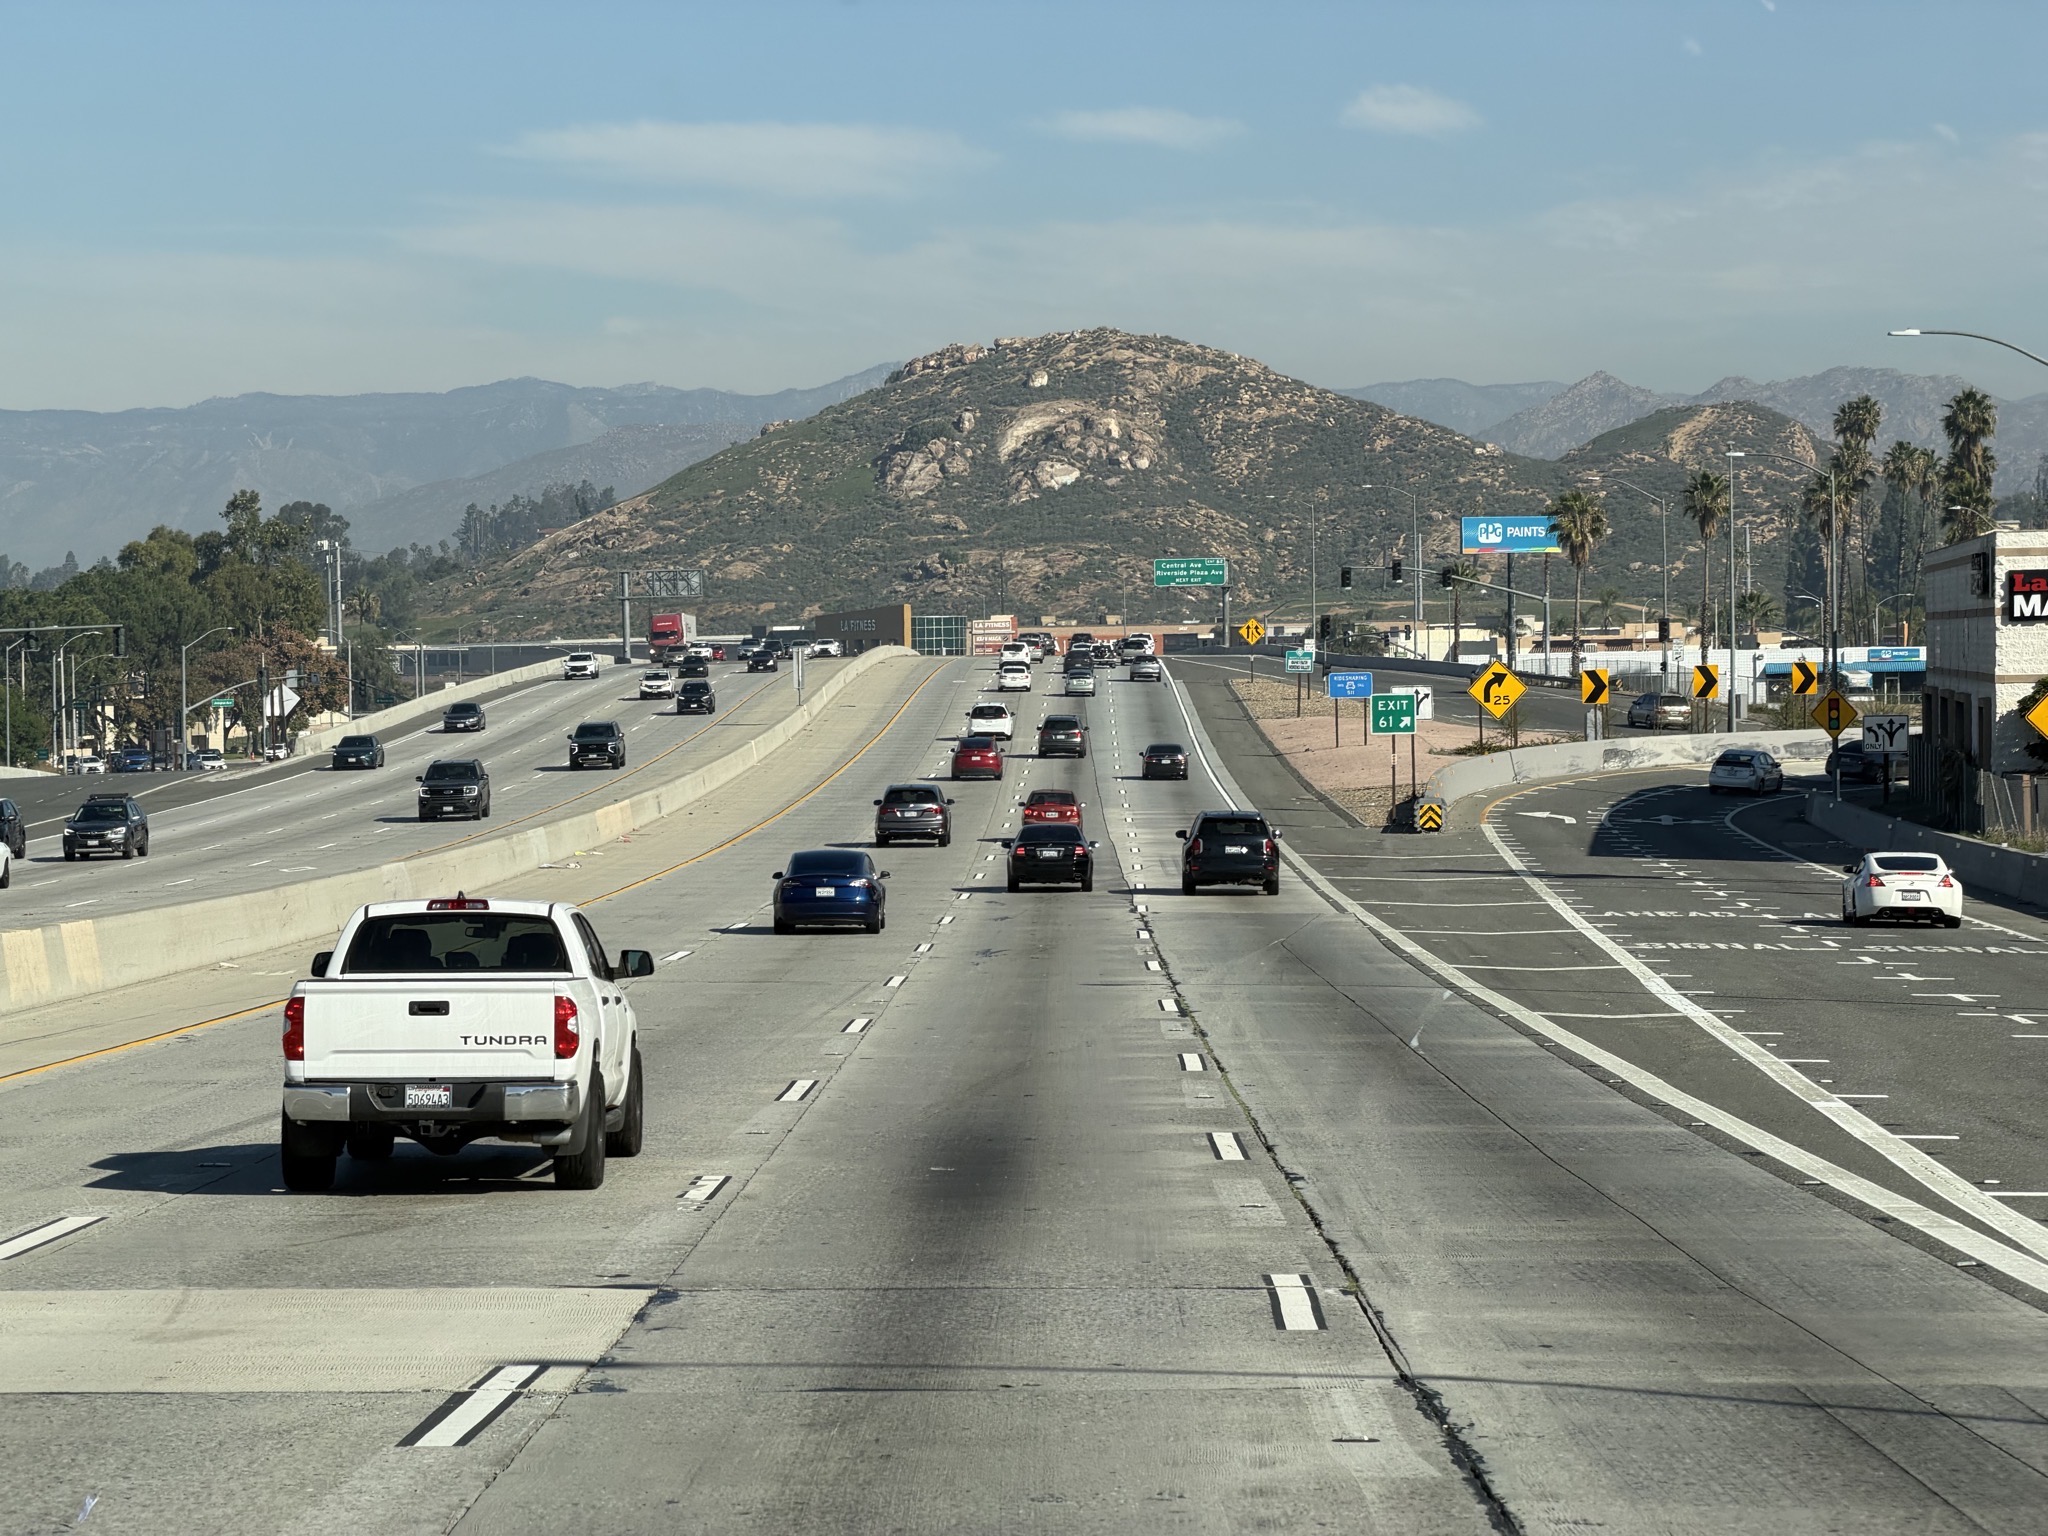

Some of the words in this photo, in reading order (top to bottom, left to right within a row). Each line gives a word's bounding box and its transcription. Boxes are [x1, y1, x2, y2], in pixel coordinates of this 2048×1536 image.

[1480, 522, 1502, 540] PPG
[1507, 526, 1546, 538] PAINTS
[840, 620, 849, 631] LA
[850, 619, 876, 631] FITNESS
[1378, 700, 1408, 711] EXIT
[1493, 695, 1511, 705] 25
[1378, 715, 1393, 728] 61
[1633, 942, 1800, 950] SIGNAL
[1864, 945, 2037, 954] SIGNAL
[459, 1035, 547, 1046] TUNDRA
